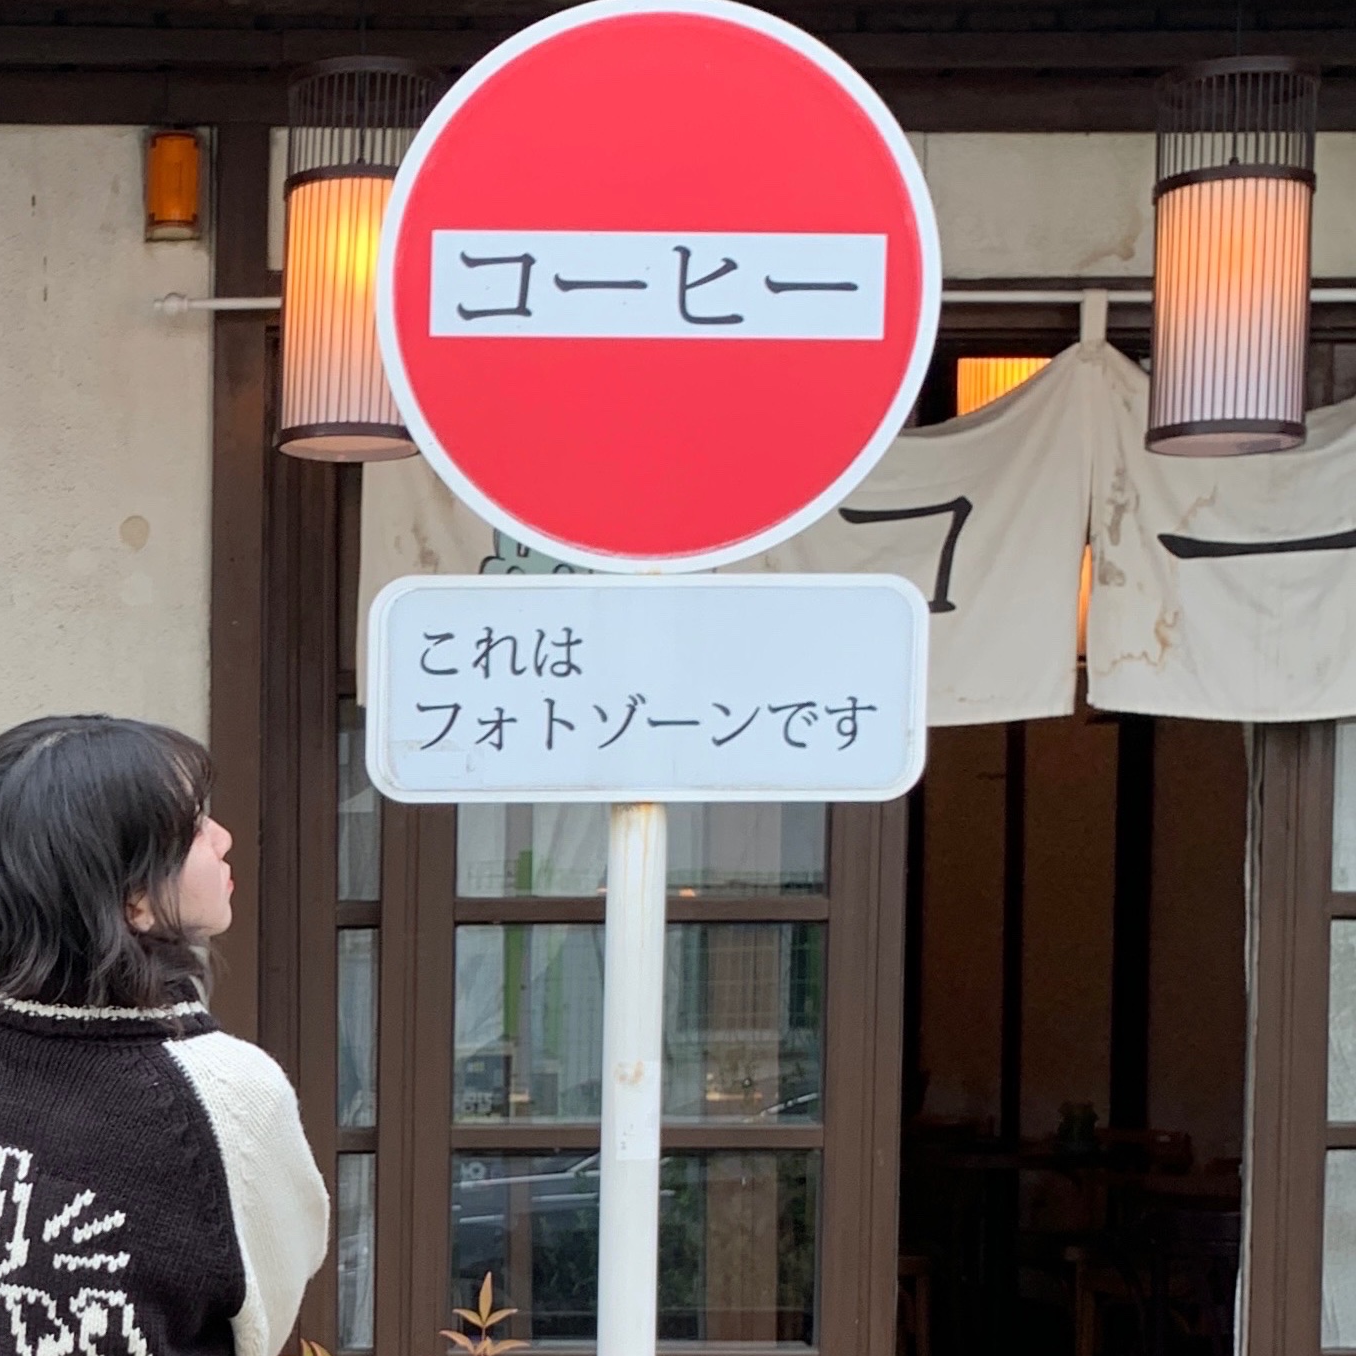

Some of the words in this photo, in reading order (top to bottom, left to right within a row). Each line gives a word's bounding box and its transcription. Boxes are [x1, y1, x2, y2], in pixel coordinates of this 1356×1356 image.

[456, 244, 859, 326] コーヒー
[418, 626, 584, 679] これは
[415, 693, 879, 752] フォトゾーンです
